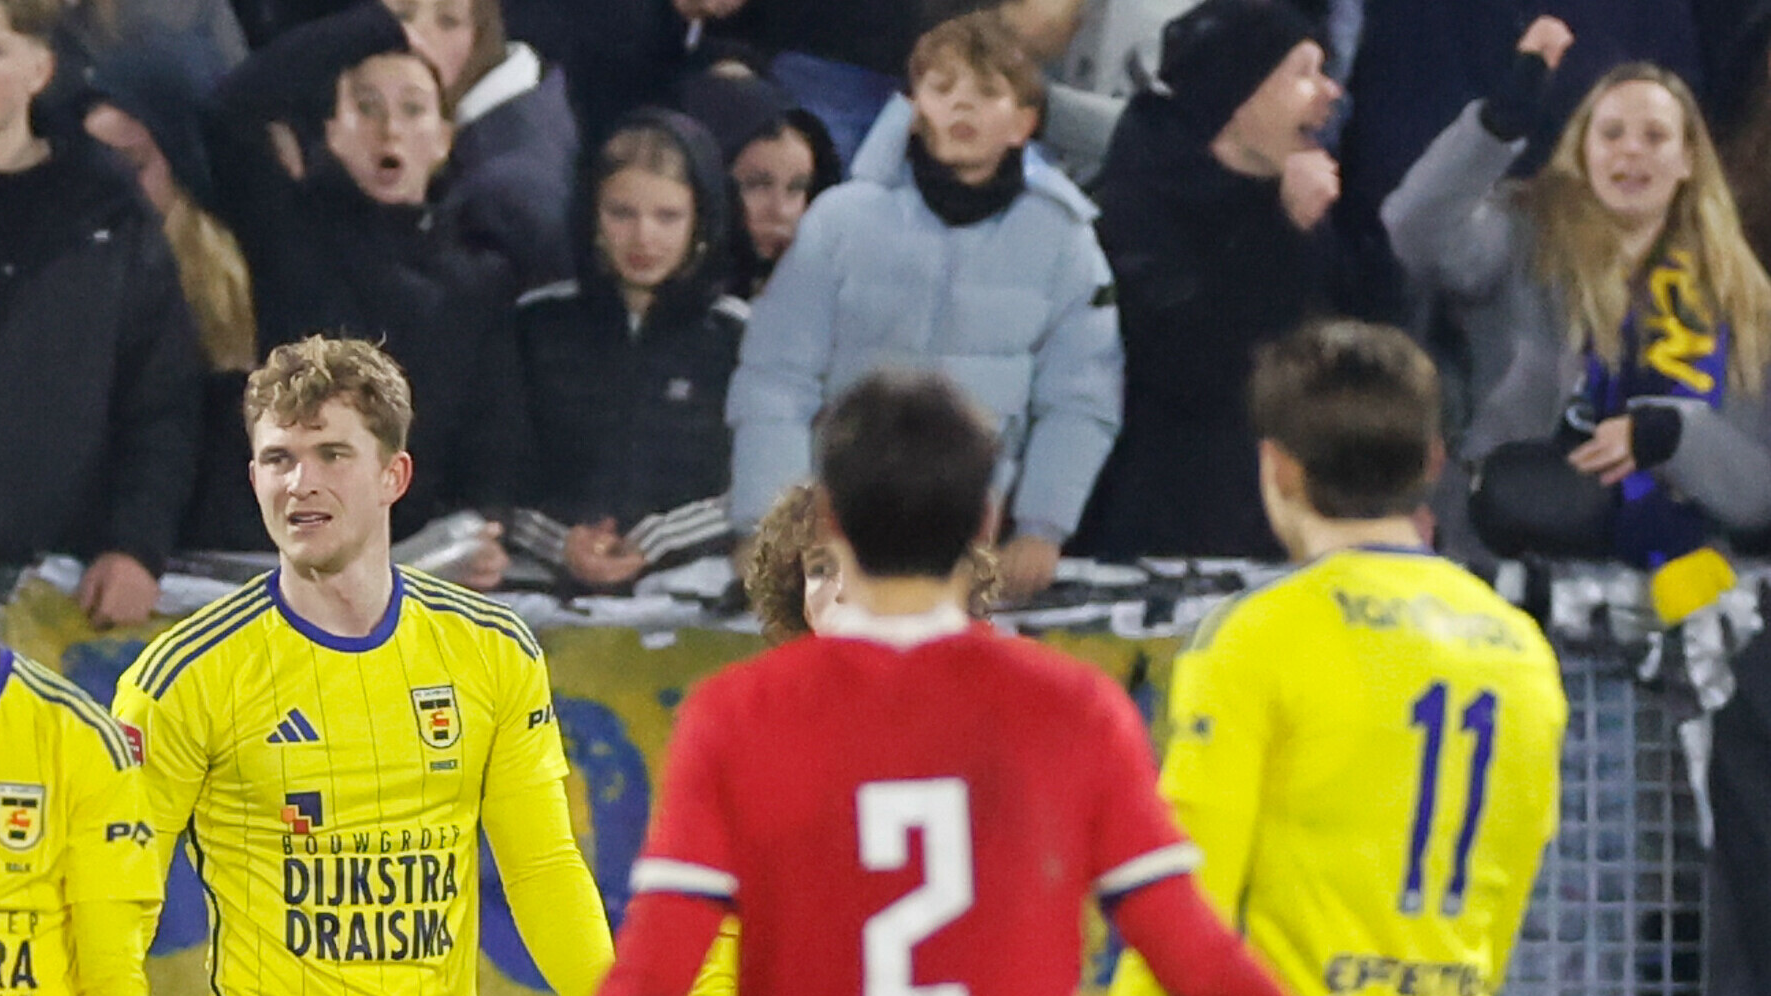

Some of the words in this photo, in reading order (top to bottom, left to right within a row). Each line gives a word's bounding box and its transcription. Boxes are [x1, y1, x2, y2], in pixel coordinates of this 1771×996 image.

[1398, 680, 1497, 917] 11
[104, 821, 154, 849] PA
[284, 853, 458, 907] DIJKSTRA
[286, 908, 454, 961] DRAISMA
